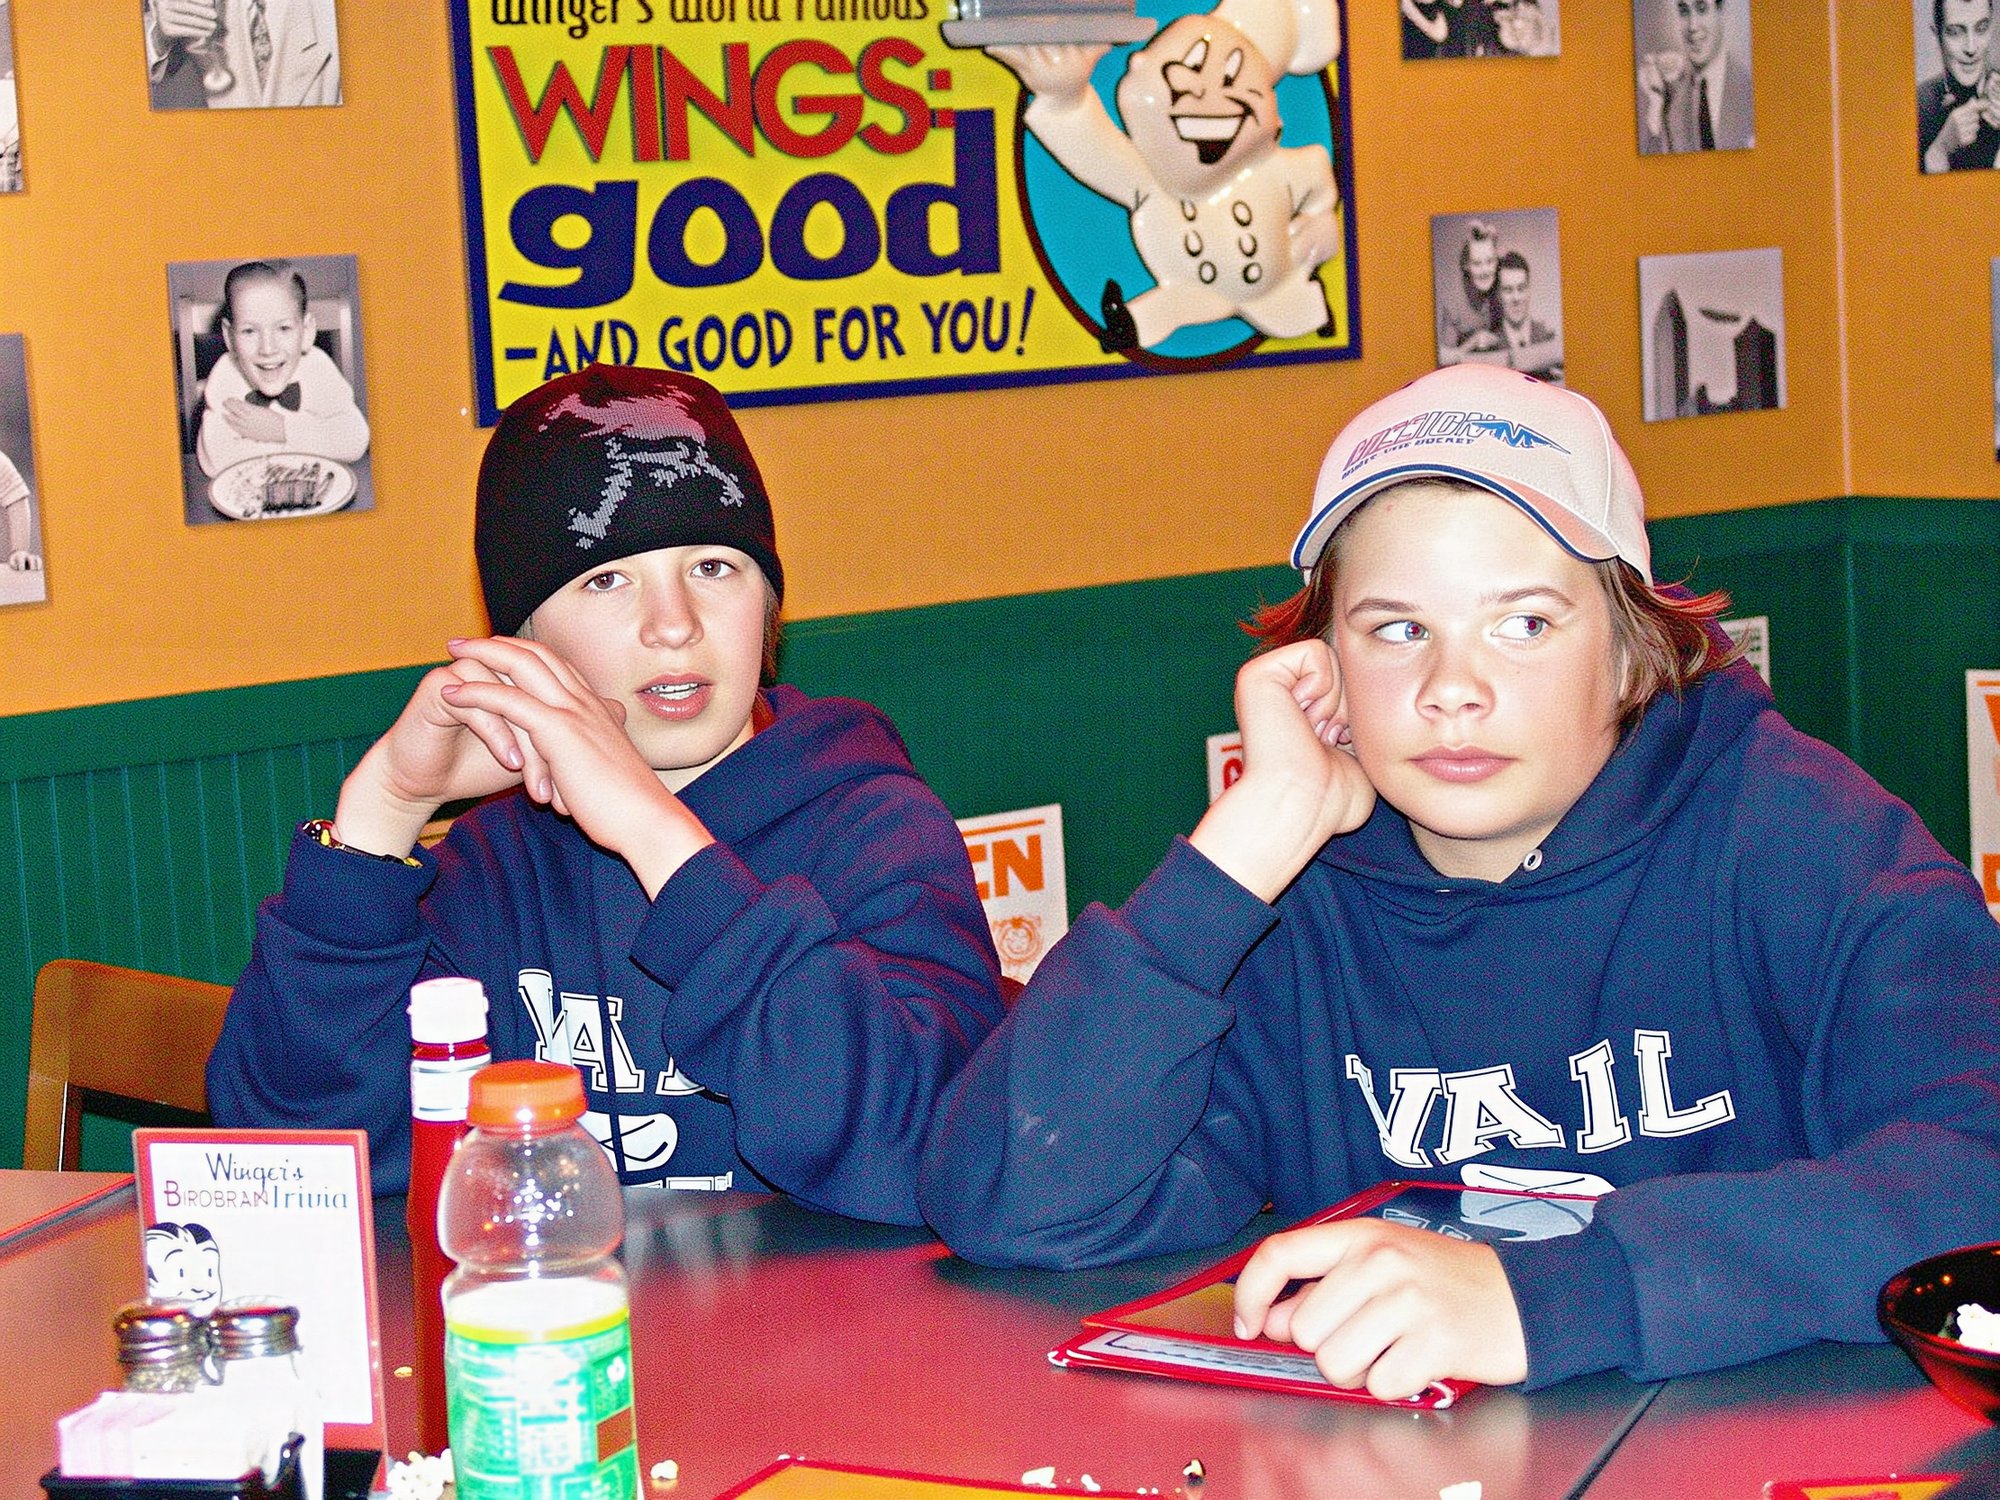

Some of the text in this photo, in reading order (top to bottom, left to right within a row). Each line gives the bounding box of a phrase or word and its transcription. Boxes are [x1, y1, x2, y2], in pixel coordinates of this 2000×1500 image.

[486, 37, 955, 164] WINGS:
[497, 108, 1001, 308] good
[658, 308, 793, 373] GOOD
[814, 303, 904, 364] FOR
[928, 287, 1036, 358] YOU!
[1344, 1028, 1737, 1169] VAIL
